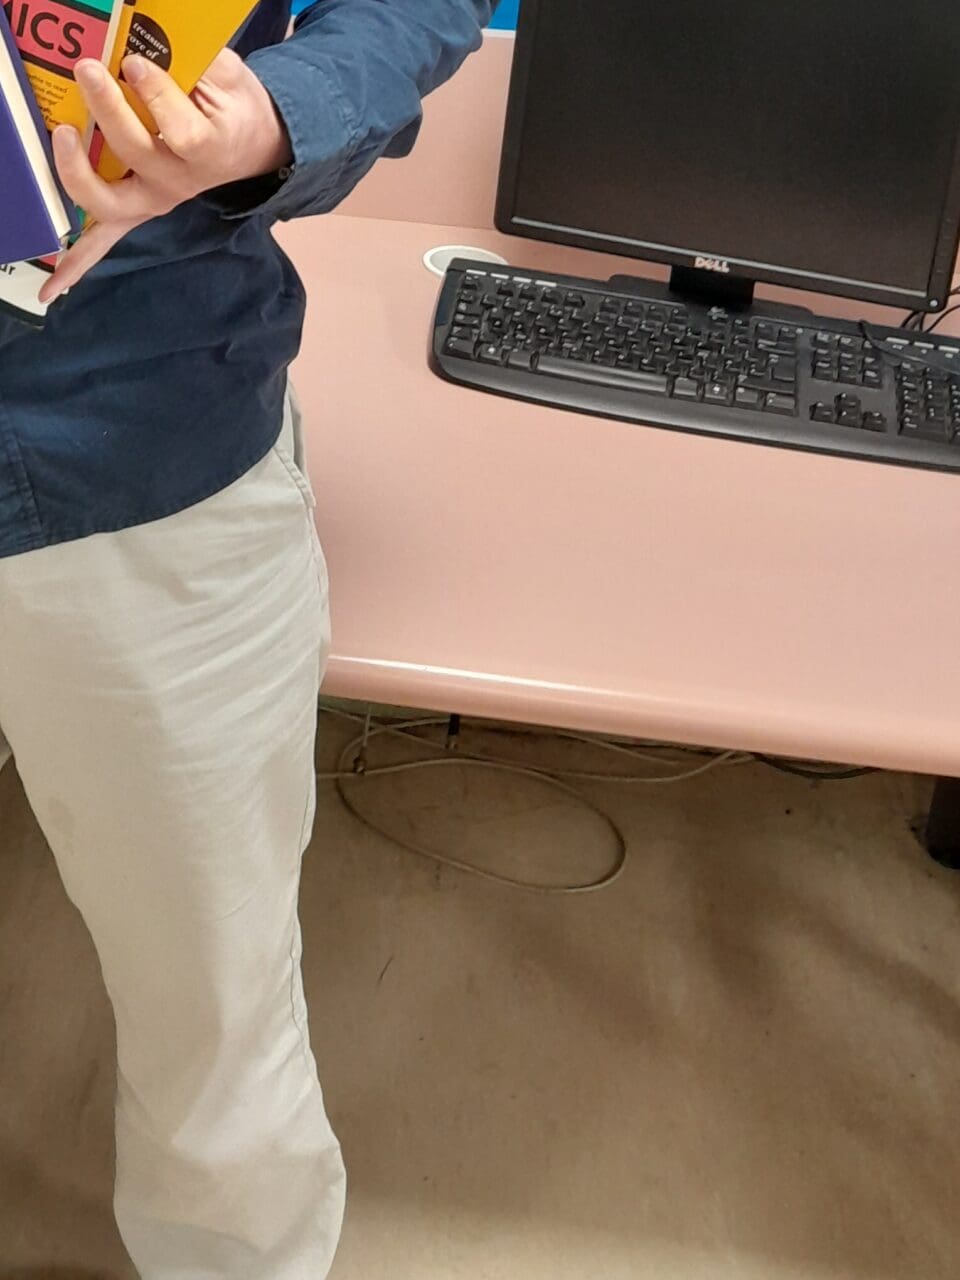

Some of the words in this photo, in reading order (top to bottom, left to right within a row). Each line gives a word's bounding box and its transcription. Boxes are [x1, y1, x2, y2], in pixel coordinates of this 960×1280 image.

[129, 33, 146, 50] ove
[145, 49, 160, 59] of
[132, 22, 169, 54] treasure
[694, 256, 730, 273] DELL
